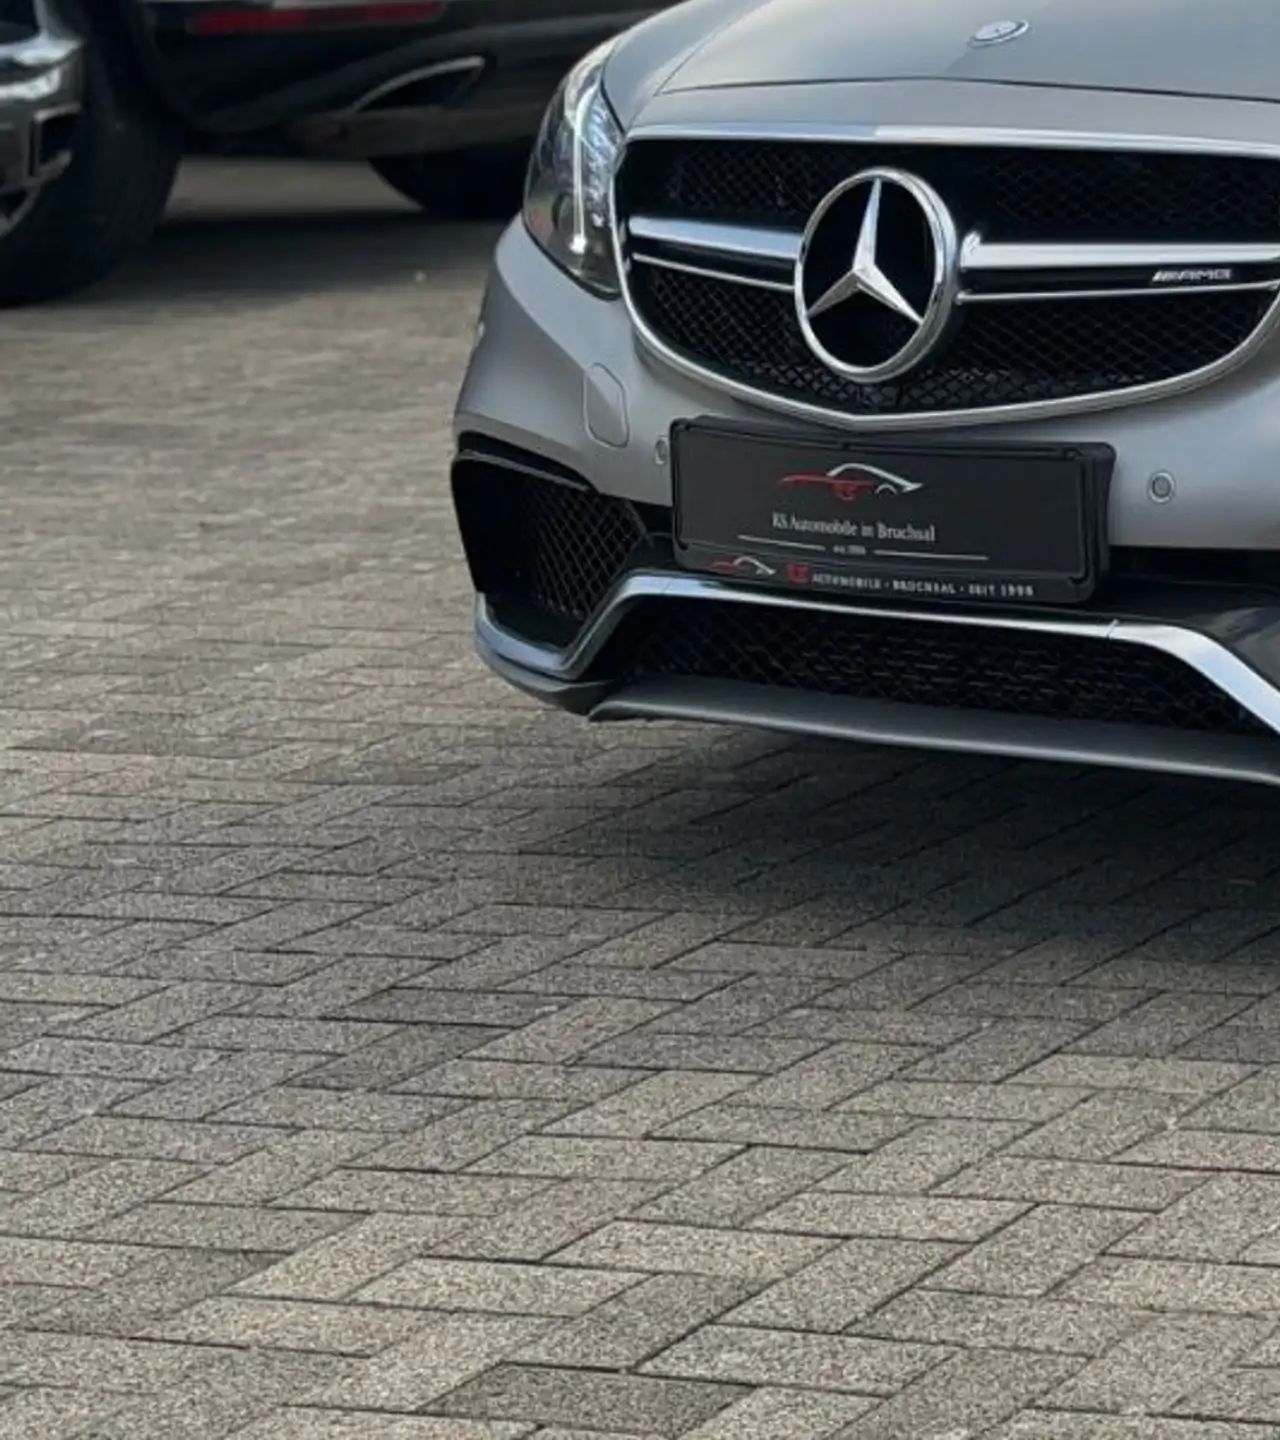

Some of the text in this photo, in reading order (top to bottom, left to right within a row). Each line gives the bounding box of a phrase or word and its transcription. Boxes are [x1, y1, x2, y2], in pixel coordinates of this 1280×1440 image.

[790, 513, 858, 537] Automobile
[861, 523, 874, 538] in
[877, 521, 936, 542] Bruchsal
